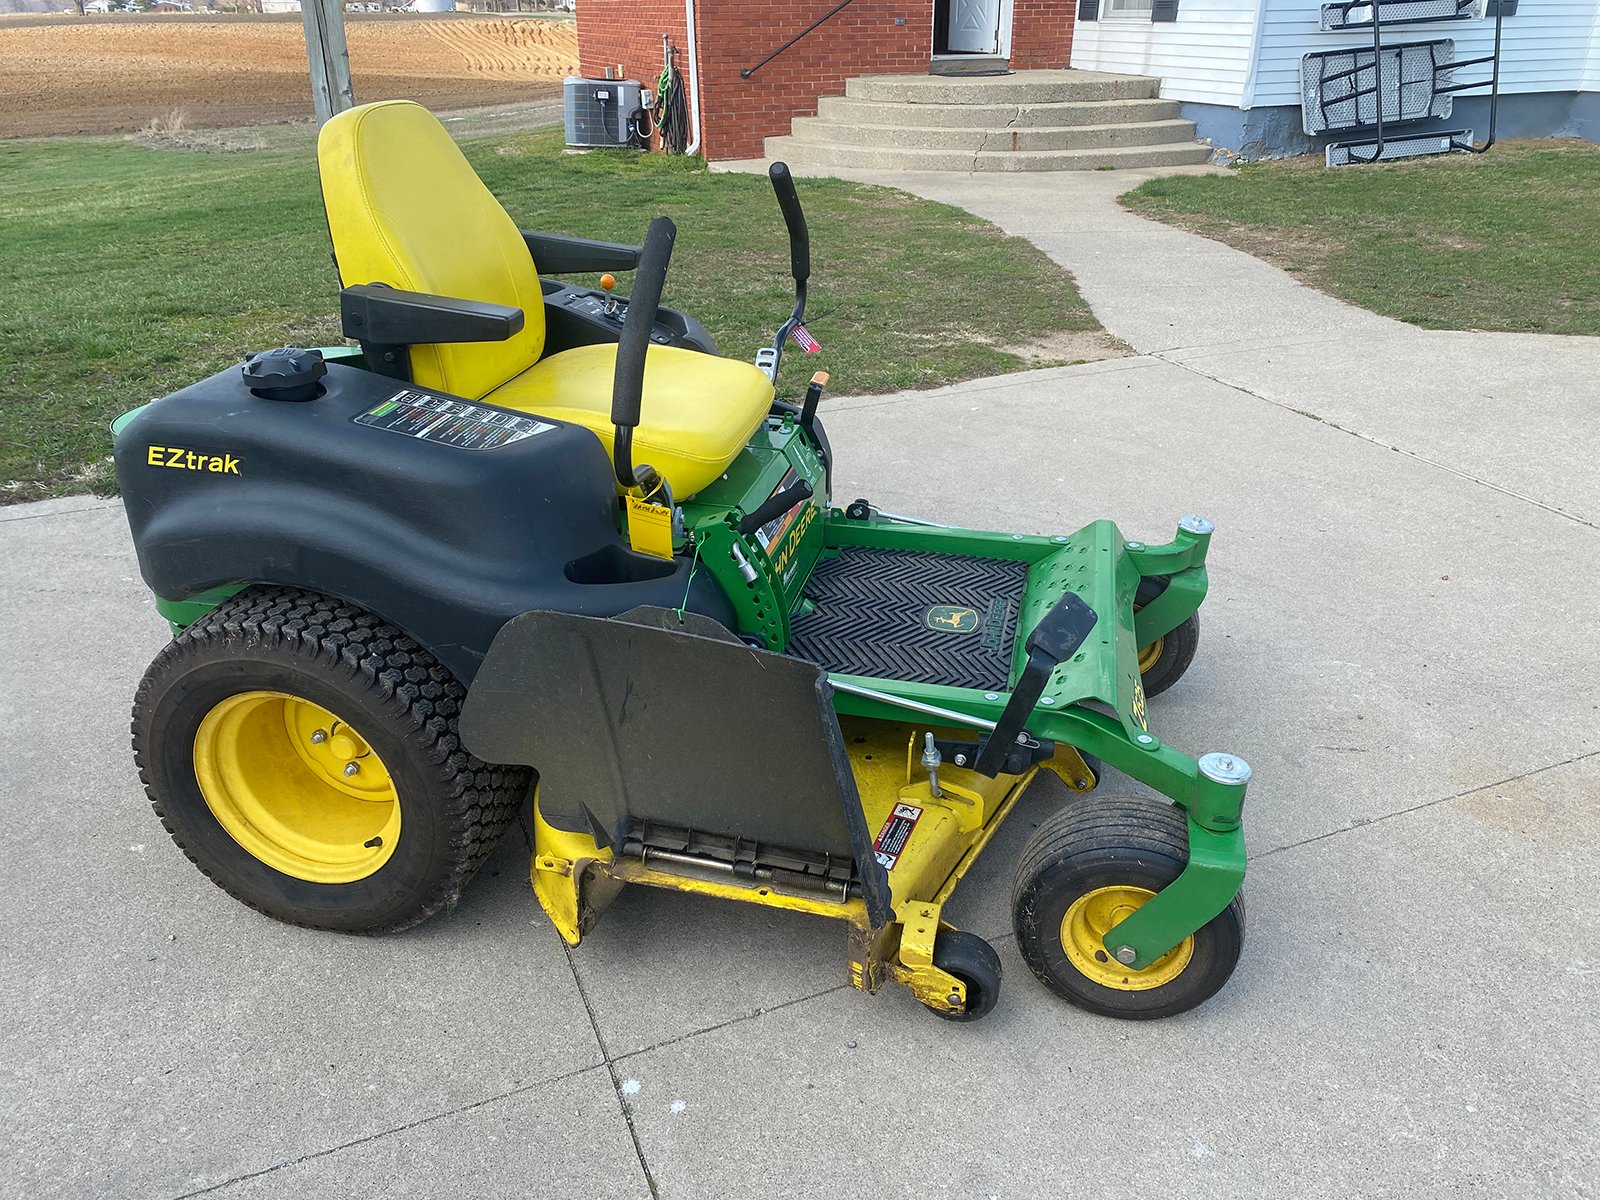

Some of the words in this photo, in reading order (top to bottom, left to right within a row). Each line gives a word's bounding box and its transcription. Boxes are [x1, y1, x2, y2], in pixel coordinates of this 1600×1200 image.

[147, 445, 240, 475] EZtrak
[789, 499, 817, 557] DEERE
[988, 599, 1007, 625] DEERE
[985, 626, 1001, 651] JOHN
